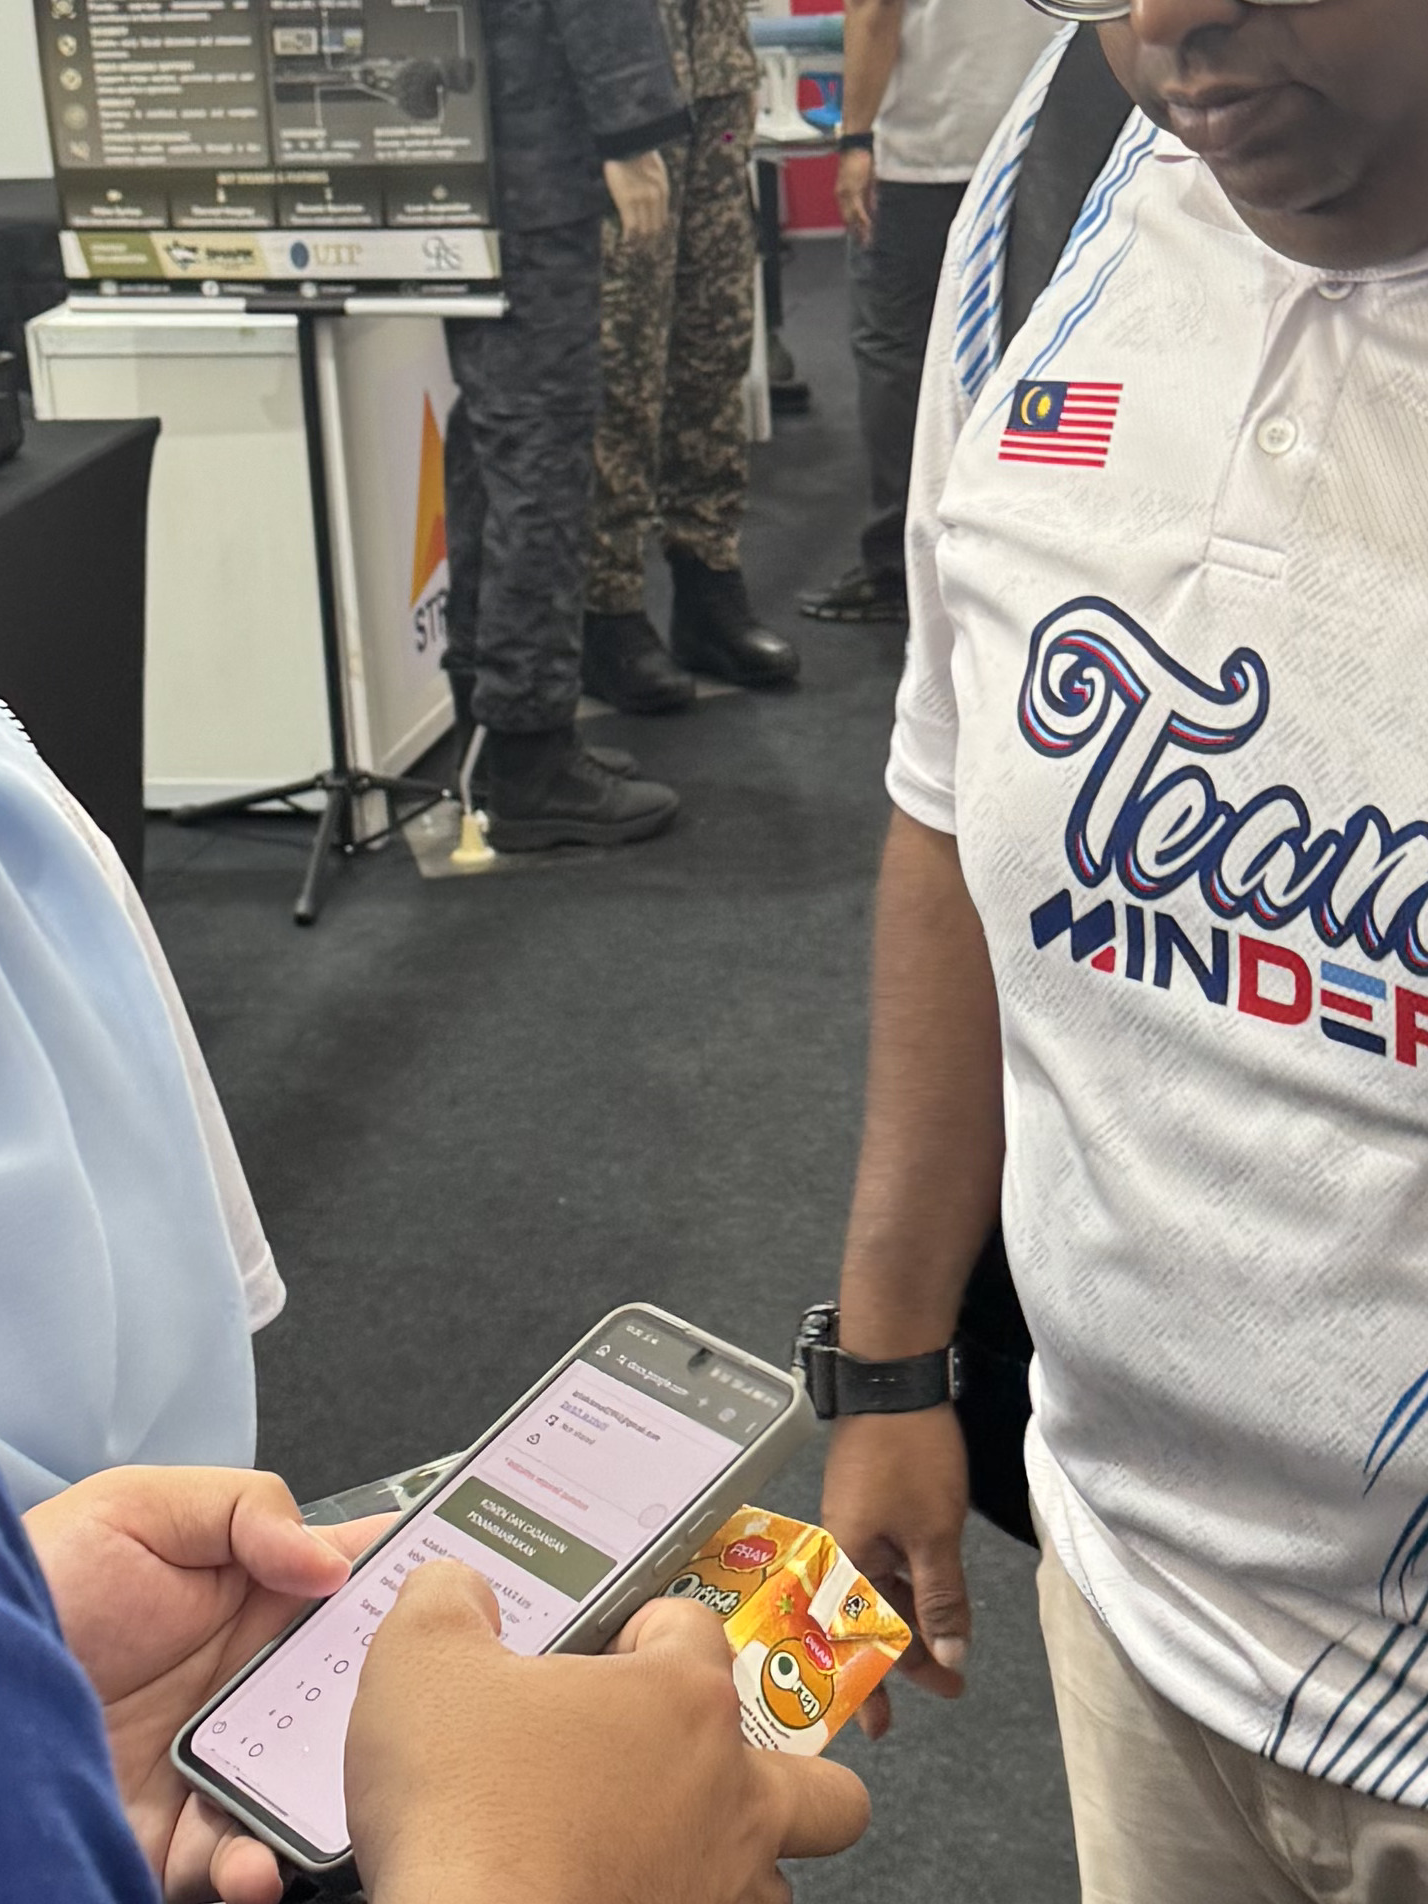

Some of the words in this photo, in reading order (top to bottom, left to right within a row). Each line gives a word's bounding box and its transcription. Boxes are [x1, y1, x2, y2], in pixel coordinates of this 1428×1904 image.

[312, 242, 363, 267] UTP
[413, 587, 450, 654] STR
[769, 1651, 821, 1722] Oren
